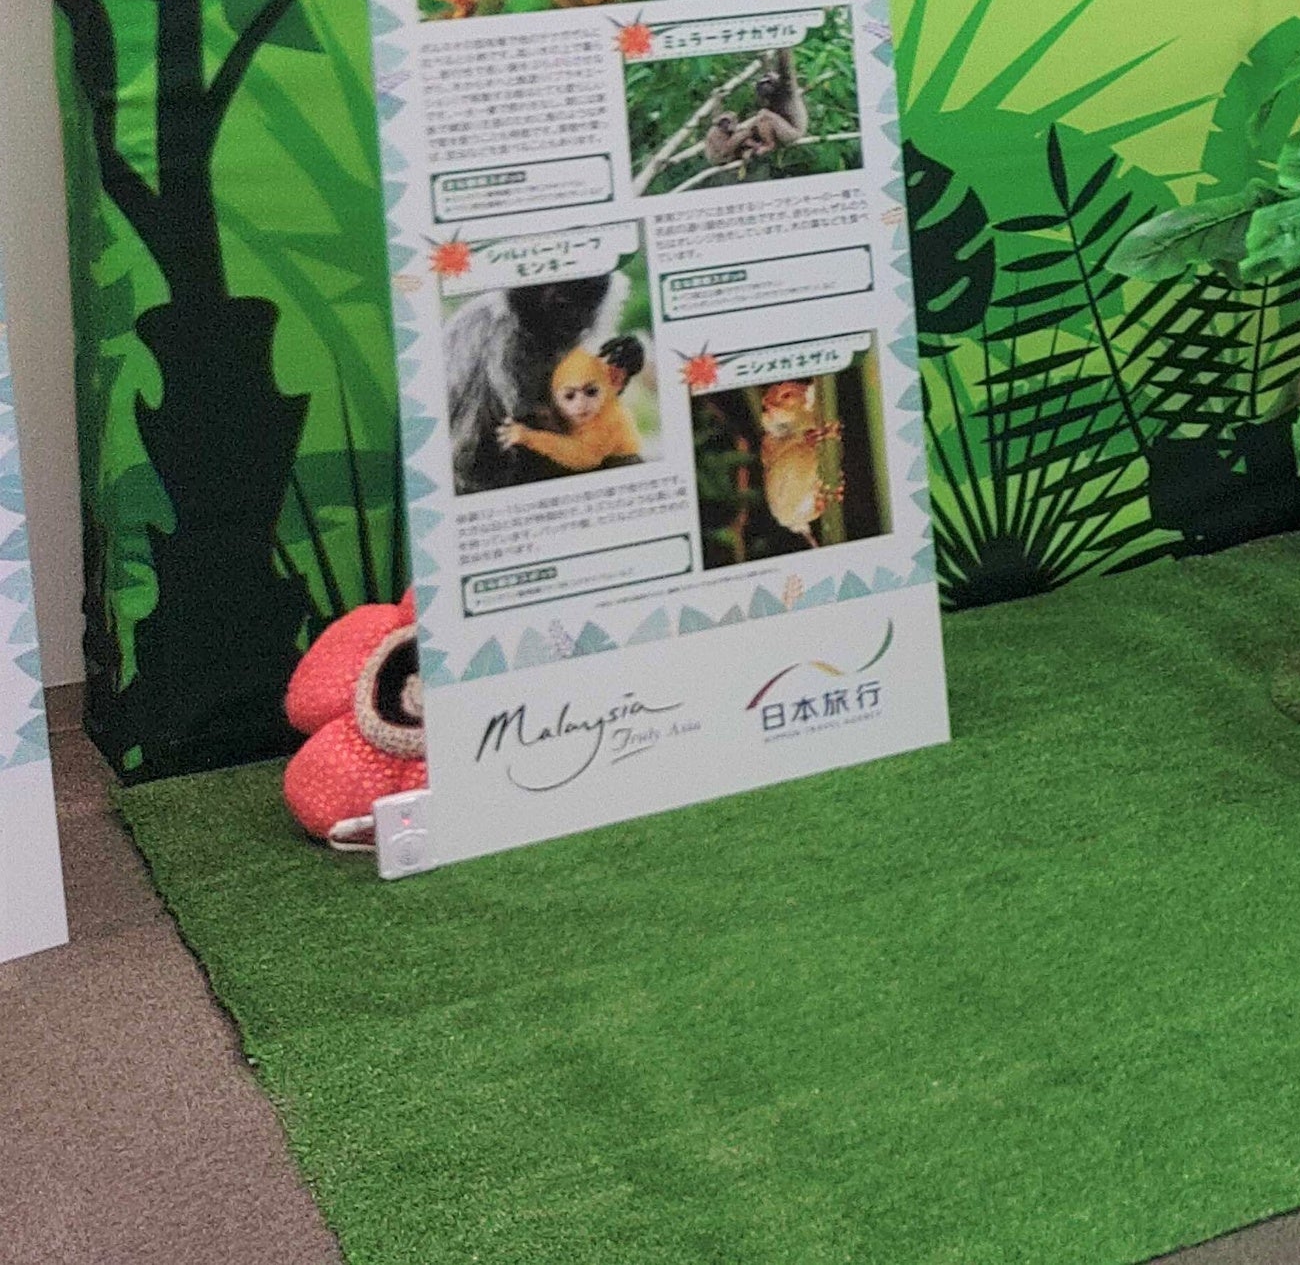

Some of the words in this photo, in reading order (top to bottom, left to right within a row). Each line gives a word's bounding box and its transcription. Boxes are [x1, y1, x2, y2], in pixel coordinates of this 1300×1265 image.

[664, 23, 799, 49] ミュラーテナガザル
[487, 237, 602, 265] シルバーリーフ
[515, 258, 578, 278] モンキー
[735, 348, 842, 377] ニシメガネザル
[760, 680, 883, 733] 日本旅行
[474, 690, 685, 792] Malaysia
